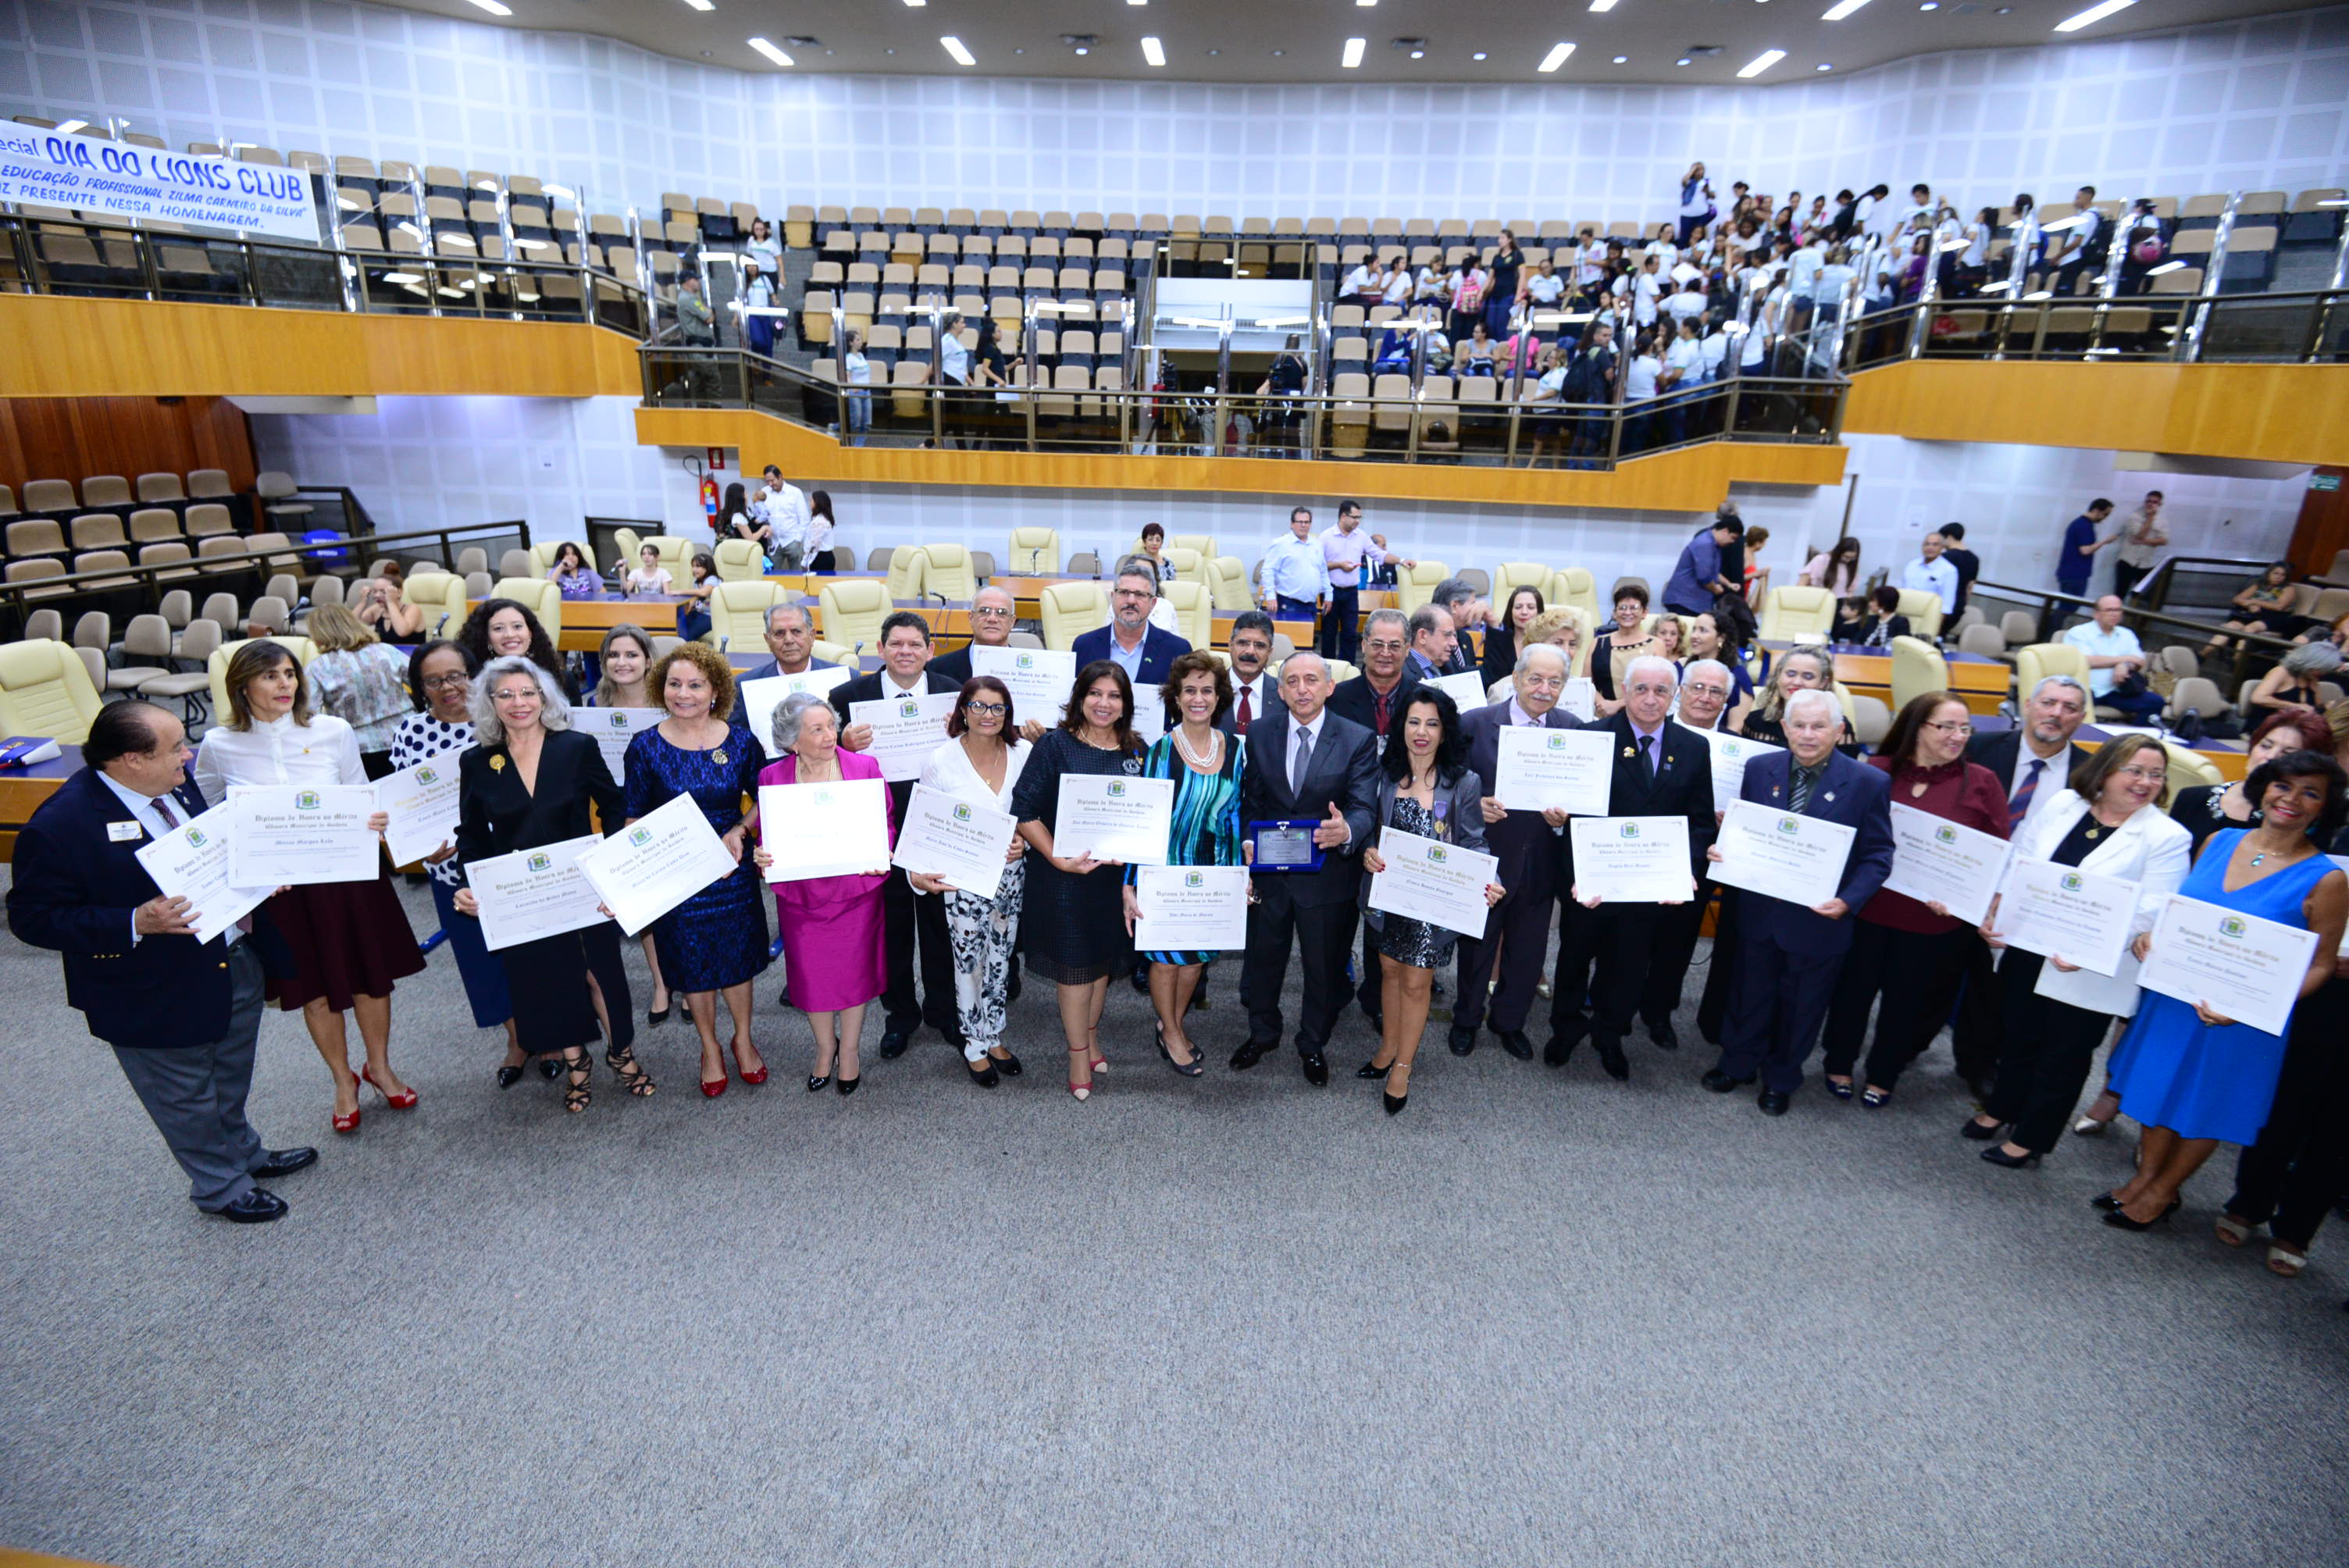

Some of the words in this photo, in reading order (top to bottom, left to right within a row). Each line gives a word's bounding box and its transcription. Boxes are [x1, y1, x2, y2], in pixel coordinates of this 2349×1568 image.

[2, 165, 79, 186] EDUCAÇÃO
[85, 177, 162, 198] PROFISSIONAL
[169, 190, 203, 204] ZILMA
[206, 196, 256, 212] CARNEIRO
[260, 204, 273, 213] DA
[46, 137, 98, 170] DIA
[102, 147, 142, 176] DO
[151, 155, 230, 190] LIONS
[237, 168, 303, 201] CLUB
[20, 184, 97, 205] PRESENTE
[105, 196, 151, 212] NESSA
[160, 205, 264, 229] HOMENAGEM.
